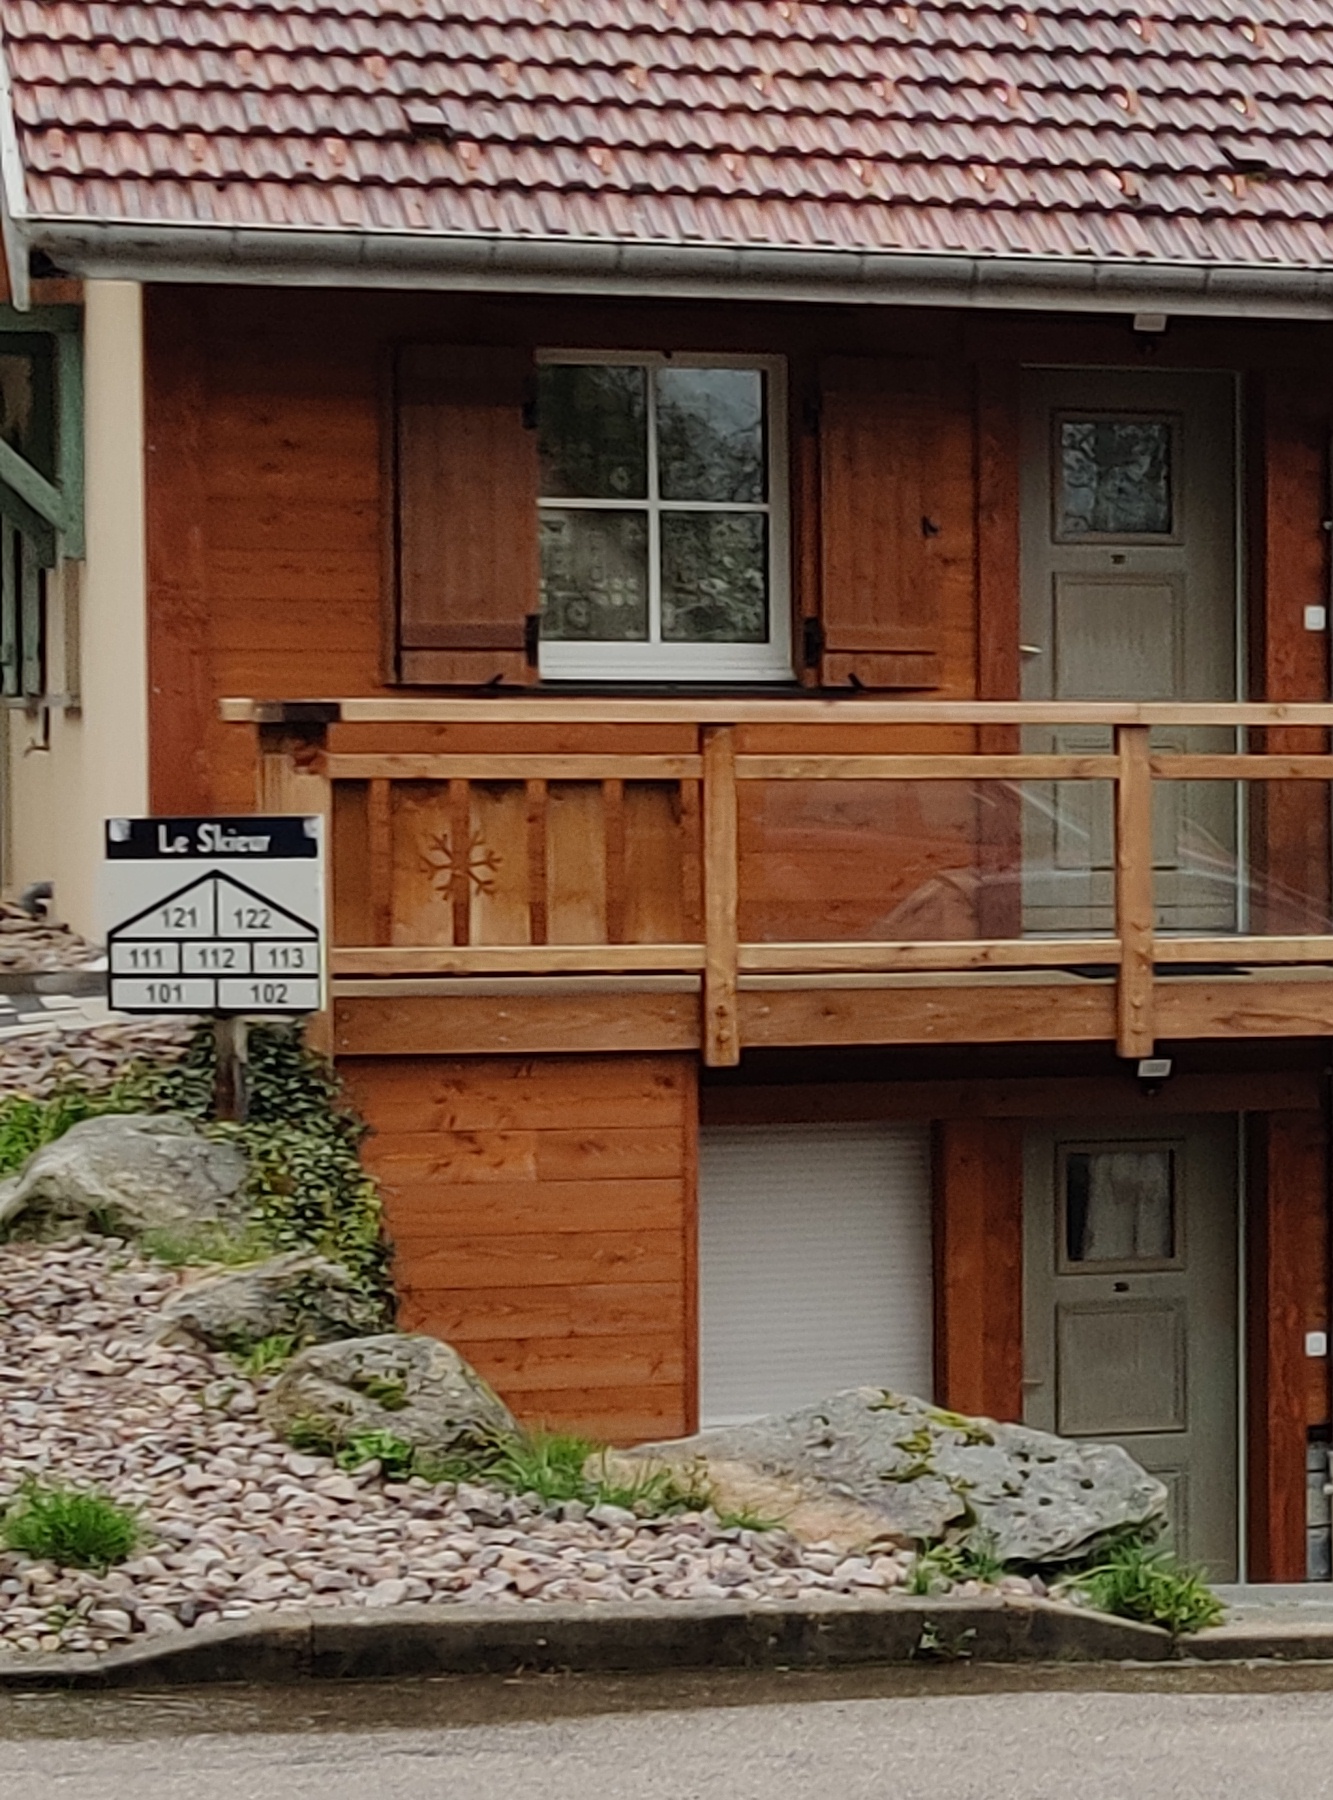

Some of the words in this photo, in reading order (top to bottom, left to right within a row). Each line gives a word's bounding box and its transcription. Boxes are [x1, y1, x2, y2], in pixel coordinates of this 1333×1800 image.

[158, 823, 190, 853] Le
[197, 822, 271, 852] Skieur
[161, 906, 198, 929] 121
[233, 907, 273, 930] 122
[129, 947, 163, 969] 111
[198, 947, 236, 969] 112
[268, 947, 305, 969] 113
[146, 983, 183, 1004] 101
[250, 983, 289, 1004] 102
